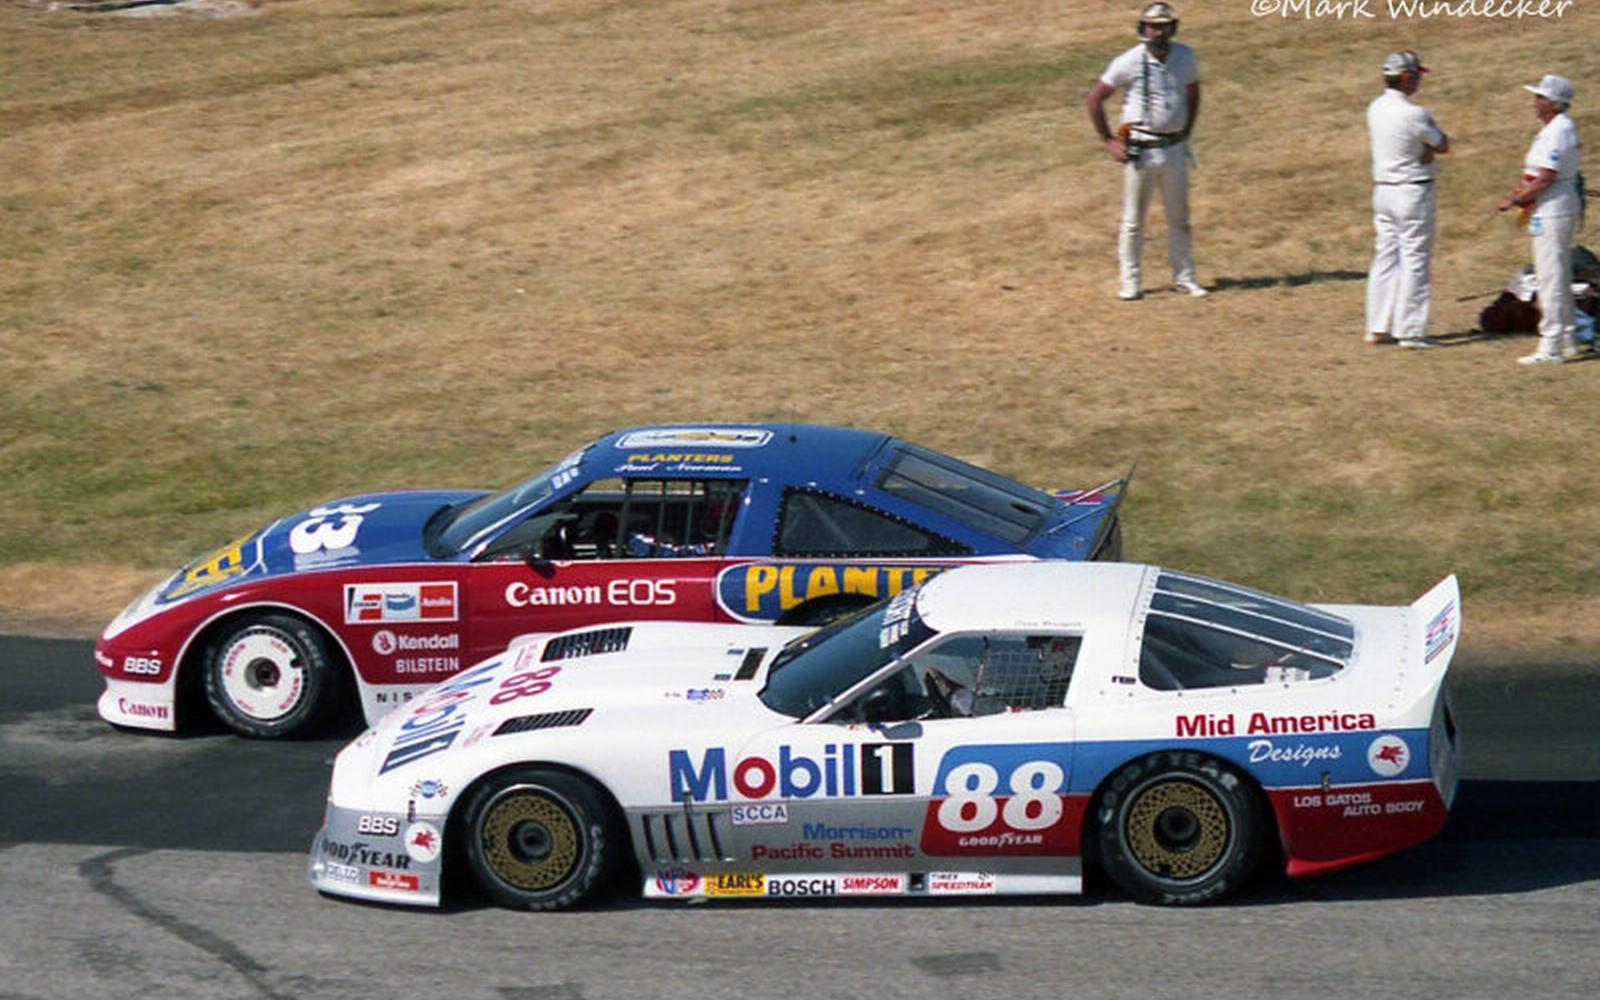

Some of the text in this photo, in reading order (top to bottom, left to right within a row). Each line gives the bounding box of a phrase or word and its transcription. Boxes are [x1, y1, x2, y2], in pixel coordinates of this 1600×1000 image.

[627, 453, 733, 463] PLANTERS
[505, 579, 677, 607] Canon EOS
[745, 566, 950, 612] PLANTE
[398, 634, 459, 649] Kendall
[124, 656, 162, 675] BBS
[396, 657, 460, 673] BILSTEIN
[376, 692, 414, 703] NIS
[118, 697, 168, 718] Canon
[1175, 711, 1375, 737] Mid America
[1247, 740, 1343, 767] Designs
[669, 743, 856, 802] Mobil
[937, 760, 1066, 832] 88
[1294, 793, 1372, 808] LOS GATOS
[733, 805, 787, 821] SCCA
[1343, 801, 1425, 816] AUTO BODY
[358, 815, 401, 836] BBS
[802, 823, 913, 841] Morrison-
[958, 832, 1043, 848] GOODYEAR
[751, 842, 915, 861] Pacific Summit
[718, 872, 764, 889] EARL'S
[768, 879, 836, 895] BOSCH
[842, 877, 899, 891] SIMPSON
